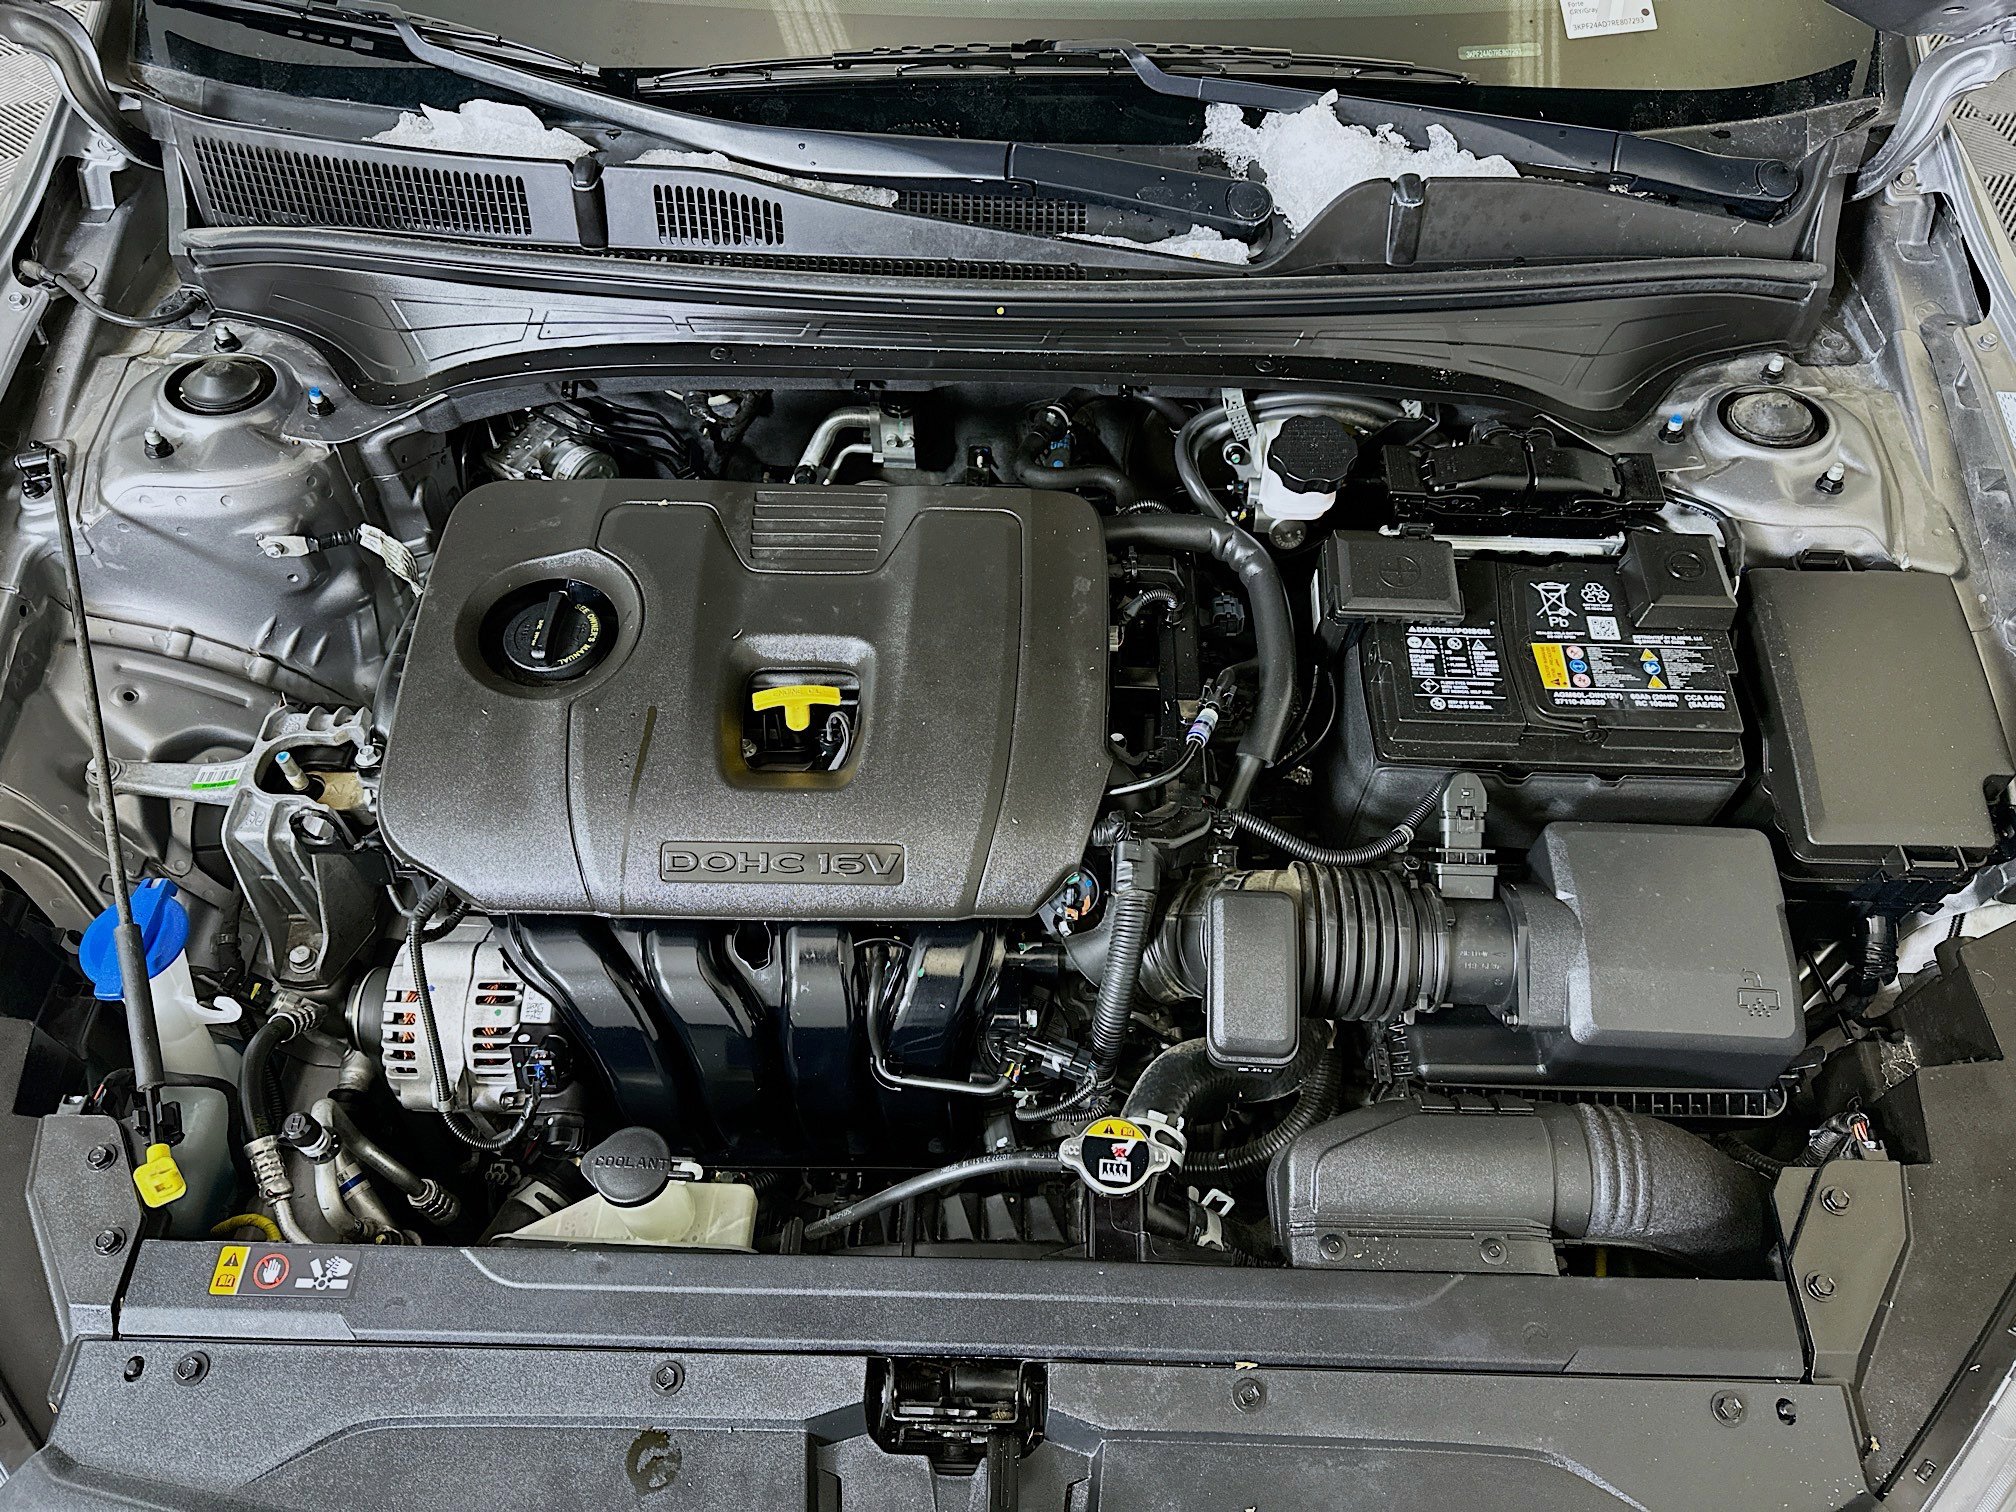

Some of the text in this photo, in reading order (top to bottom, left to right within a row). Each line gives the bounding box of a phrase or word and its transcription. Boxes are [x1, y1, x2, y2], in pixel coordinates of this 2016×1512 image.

[1572, 17, 1644, 31] 3KPF24AD7RE807293
[1548, 616, 1570, 628] Pb
[557, 603, 599, 665] SEE OWNER'S MANUAL
[1416, 626, 1491, 635] DANGER/POISON
[664, 851, 900, 875] DOHC 16V
[595, 1156, 669, 1170] COOLANT
